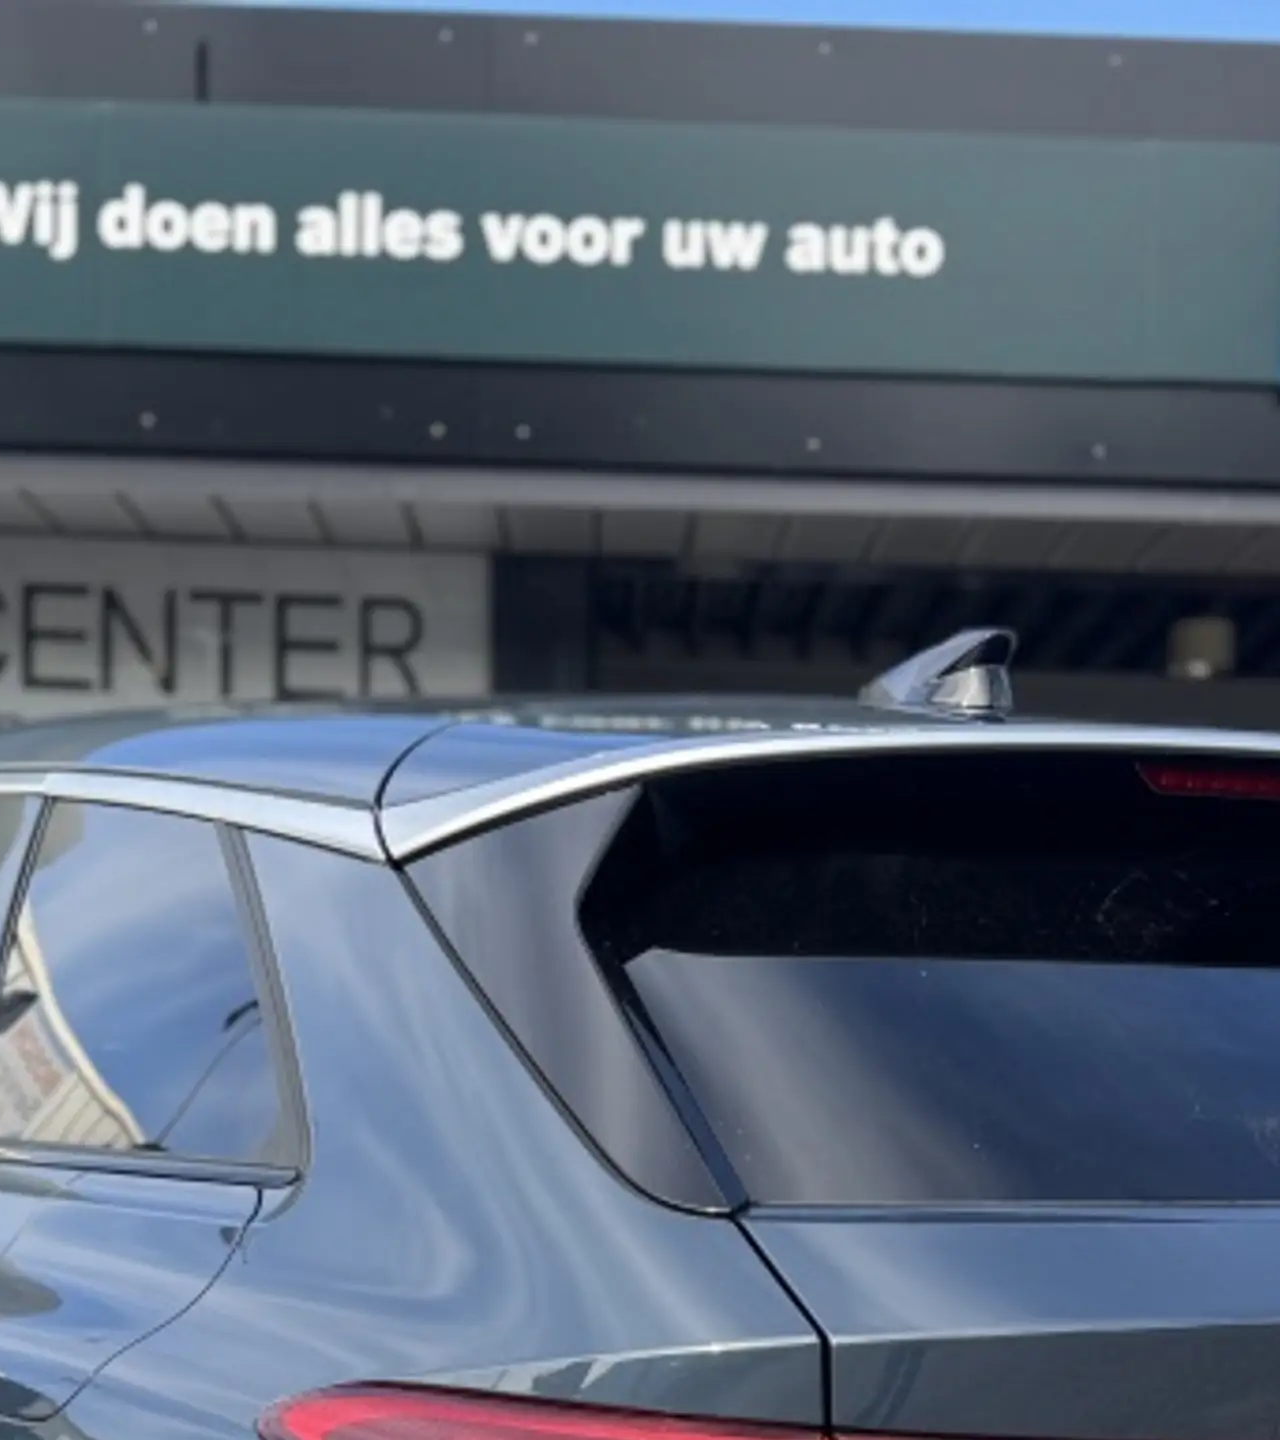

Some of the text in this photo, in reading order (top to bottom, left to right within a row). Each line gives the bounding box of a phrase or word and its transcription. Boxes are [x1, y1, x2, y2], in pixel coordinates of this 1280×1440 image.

[97, 182, 278, 254] doen
[295, 190, 464, 261] alles
[480, 212, 646, 266] voor
[662, 218, 769, 270] uw
[785, 216, 945, 277] auto
